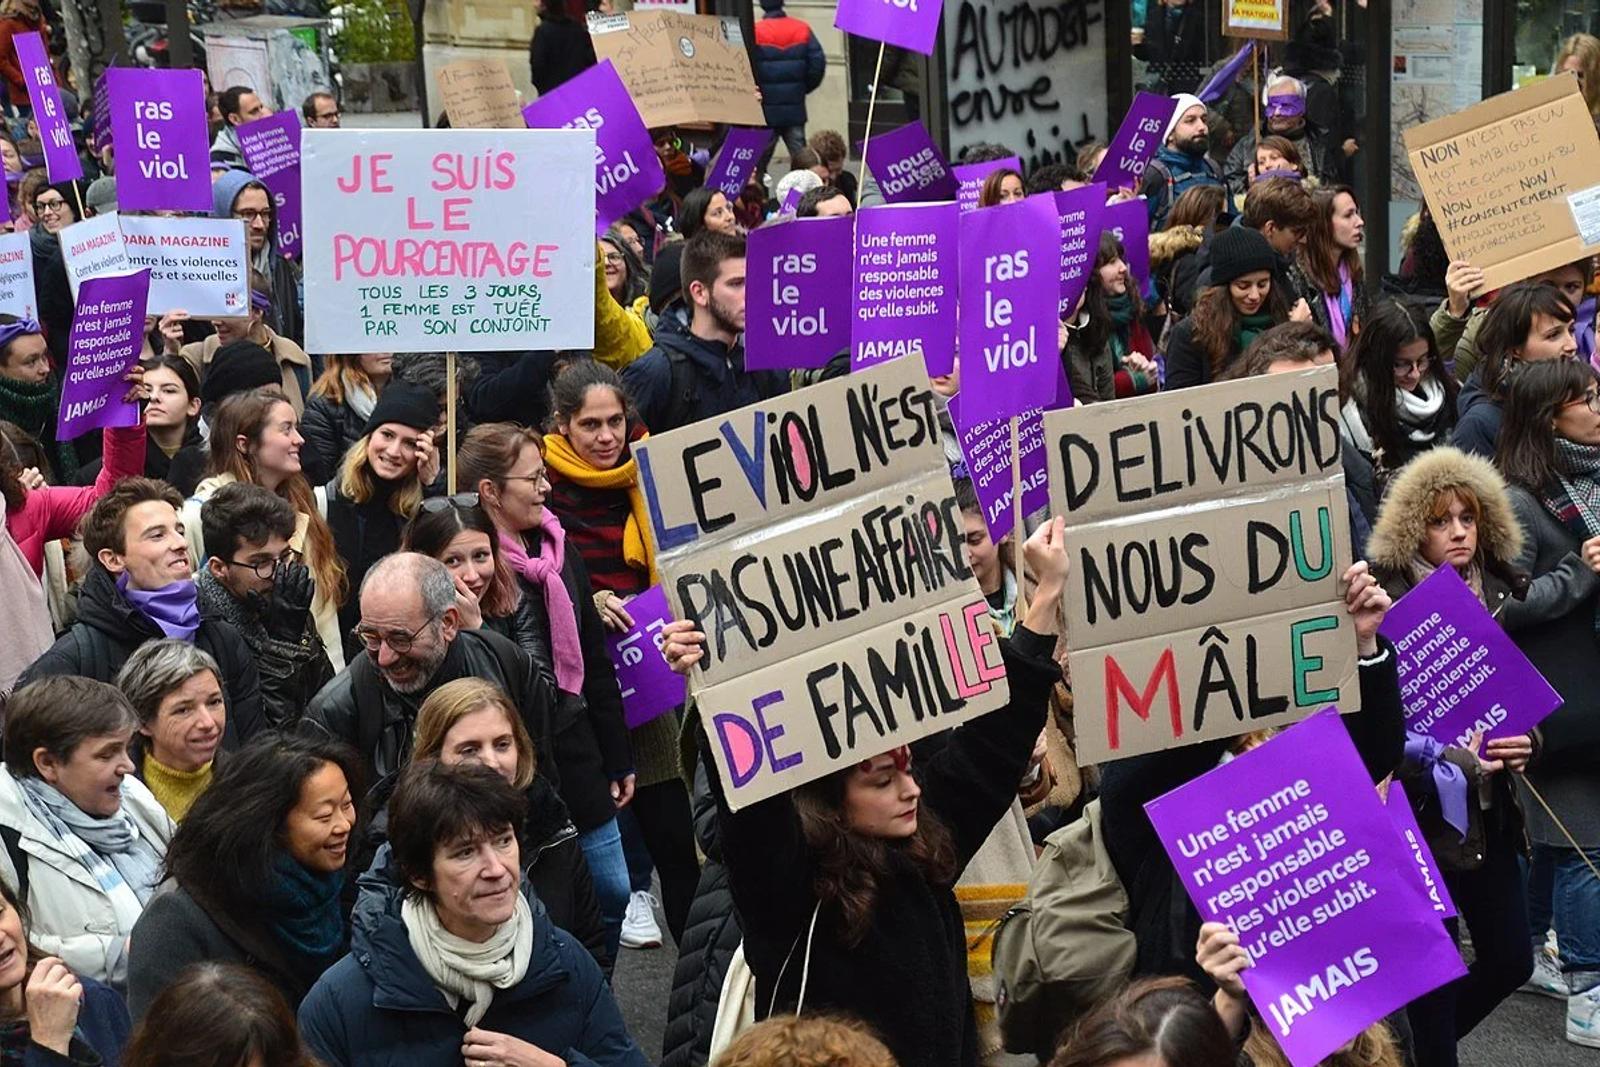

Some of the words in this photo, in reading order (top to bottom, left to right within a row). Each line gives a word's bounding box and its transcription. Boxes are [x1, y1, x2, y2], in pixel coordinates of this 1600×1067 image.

[34, 65, 52, 86] ras
[42, 91, 55, 117] le
[134, 100, 174, 120] ras
[50, 121, 70, 148] viol
[137, 124, 161, 149] le
[1138, 117, 1162, 133] ras
[1420, 141, 1461, 169] NON
[1466, 126, 1505, 149] N'EST
[1513, 115, 1537, 133] PAS
[1538, 104, 1565, 124] UN
[732, 148, 754, 161] ras
[1129, 132, 1146, 152] le
[139, 154, 189, 180] viol
[337, 154, 393, 193] JE
[595, 150, 640, 195] viol
[725, 160, 741, 178] le
[887, 147, 935, 178] nous
[1120, 155, 1150, 175] viol
[1429, 163, 1458, 185] MOT
[881, 158, 941, 196] toutes
[1441, 200, 1473, 219] NON
[1519, 169, 1548, 193] NON
[1446, 183, 1567, 232] #CONSENTEMENT
[407, 197, 473, 231] LE
[1059, 210, 1085, 224] emme
[122, 234, 156, 246] DANA
[160, 236, 230, 248] MAGAZINE
[277, 222, 300, 249] iol
[861, 232, 888, 248] Une
[890, 231, 937, 247] femme
[1060, 224, 1086, 239] amais
[128, 256, 158, 267] ontre
[161, 255, 178, 267] les
[182, 256, 238, 268] violences
[333, 234, 560, 281] POURCENTAGE
[772, 252, 817, 275] ras
[860, 250, 893, 265] n'est
[896, 248, 938, 267] jamais
[984, 249, 1030, 284] ras
[1060, 251, 1088, 267] lences
[167, 271, 179, 281] et
[182, 270, 238, 282] sexuelles
[859, 266, 940, 285] responsable
[358, 286, 402, 300] TOUS
[419, 285, 449, 299] LES
[464, 285, 477, 300] 3
[485, 283, 542, 302] JOURS,
[772, 278, 800, 306] le
[859, 286, 883, 301] des
[884, 283, 944, 299] violences
[78, 303, 98, 317] Une
[100, 299, 133, 315] femme
[360, 305, 372, 318] 1
[383, 304, 441, 316] FEMME
[452, 304, 476, 316] EST
[493, 299, 541, 318] TUÉE
[858, 302, 904, 321] qu'elle
[905, 299, 939, 317] subit.
[984, 290, 1013, 329] le
[75, 319, 101, 333] n'est
[103, 313, 132, 333] jamais
[365, 320, 399, 336] PAR
[423, 318, 457, 336] SON
[470, 317, 551, 335] CONJOINT
[772, 308, 829, 337] viol
[74, 329, 131, 351] responsable
[856, 338, 922, 362] JAMAIS
[983, 325, 1038, 373] viol
[72, 351, 91, 366] des
[92, 345, 133, 362] violences
[70, 364, 104, 385] qu'elle
[969, 406, 1044, 459] responable
[1019, 433, 1046, 458] subi
[635, 439, 736, 550] LE
[846, 382, 938, 473] N'EST
[974, 451, 994, 473] des
[988, 468, 1048, 524] JAMAIS
[1080, 532, 1216, 626] NOUS
[1247, 507, 1334, 594] DU
[677, 554, 778, 672] PAS
[763, 538, 861, 631] UNE
[616, 631, 643, 667] le
[645, 617, 668, 663] ra
[1409, 623, 1457, 668] jamais
[1400, 635, 1471, 700] sponsable
[1104, 615, 1340, 750] MÂLE
[1403, 694, 1428, 719] des
[1426, 644, 1489, 700] violences
[1413, 692, 1460, 734] qu'elle
[1458, 662, 1497, 698] subit.
[713, 690, 803, 788] DE
[1449, 703, 1508, 749] MAIS
[1177, 824, 1229, 858] Une
[1226, 779, 1312, 830] femme
[1192, 848, 1253, 887] n'est
[1252, 802, 1329, 861] jamais
[1207, 827, 1347, 915] responsable
[1404, 828, 1446, 913] JAMAIS
[1226, 908, 1265, 938] des
[1263, 847, 1371, 917] violences
[1314, 879, 1378, 925] subit.
[1268, 946, 1380, 1037] JAMAIS
